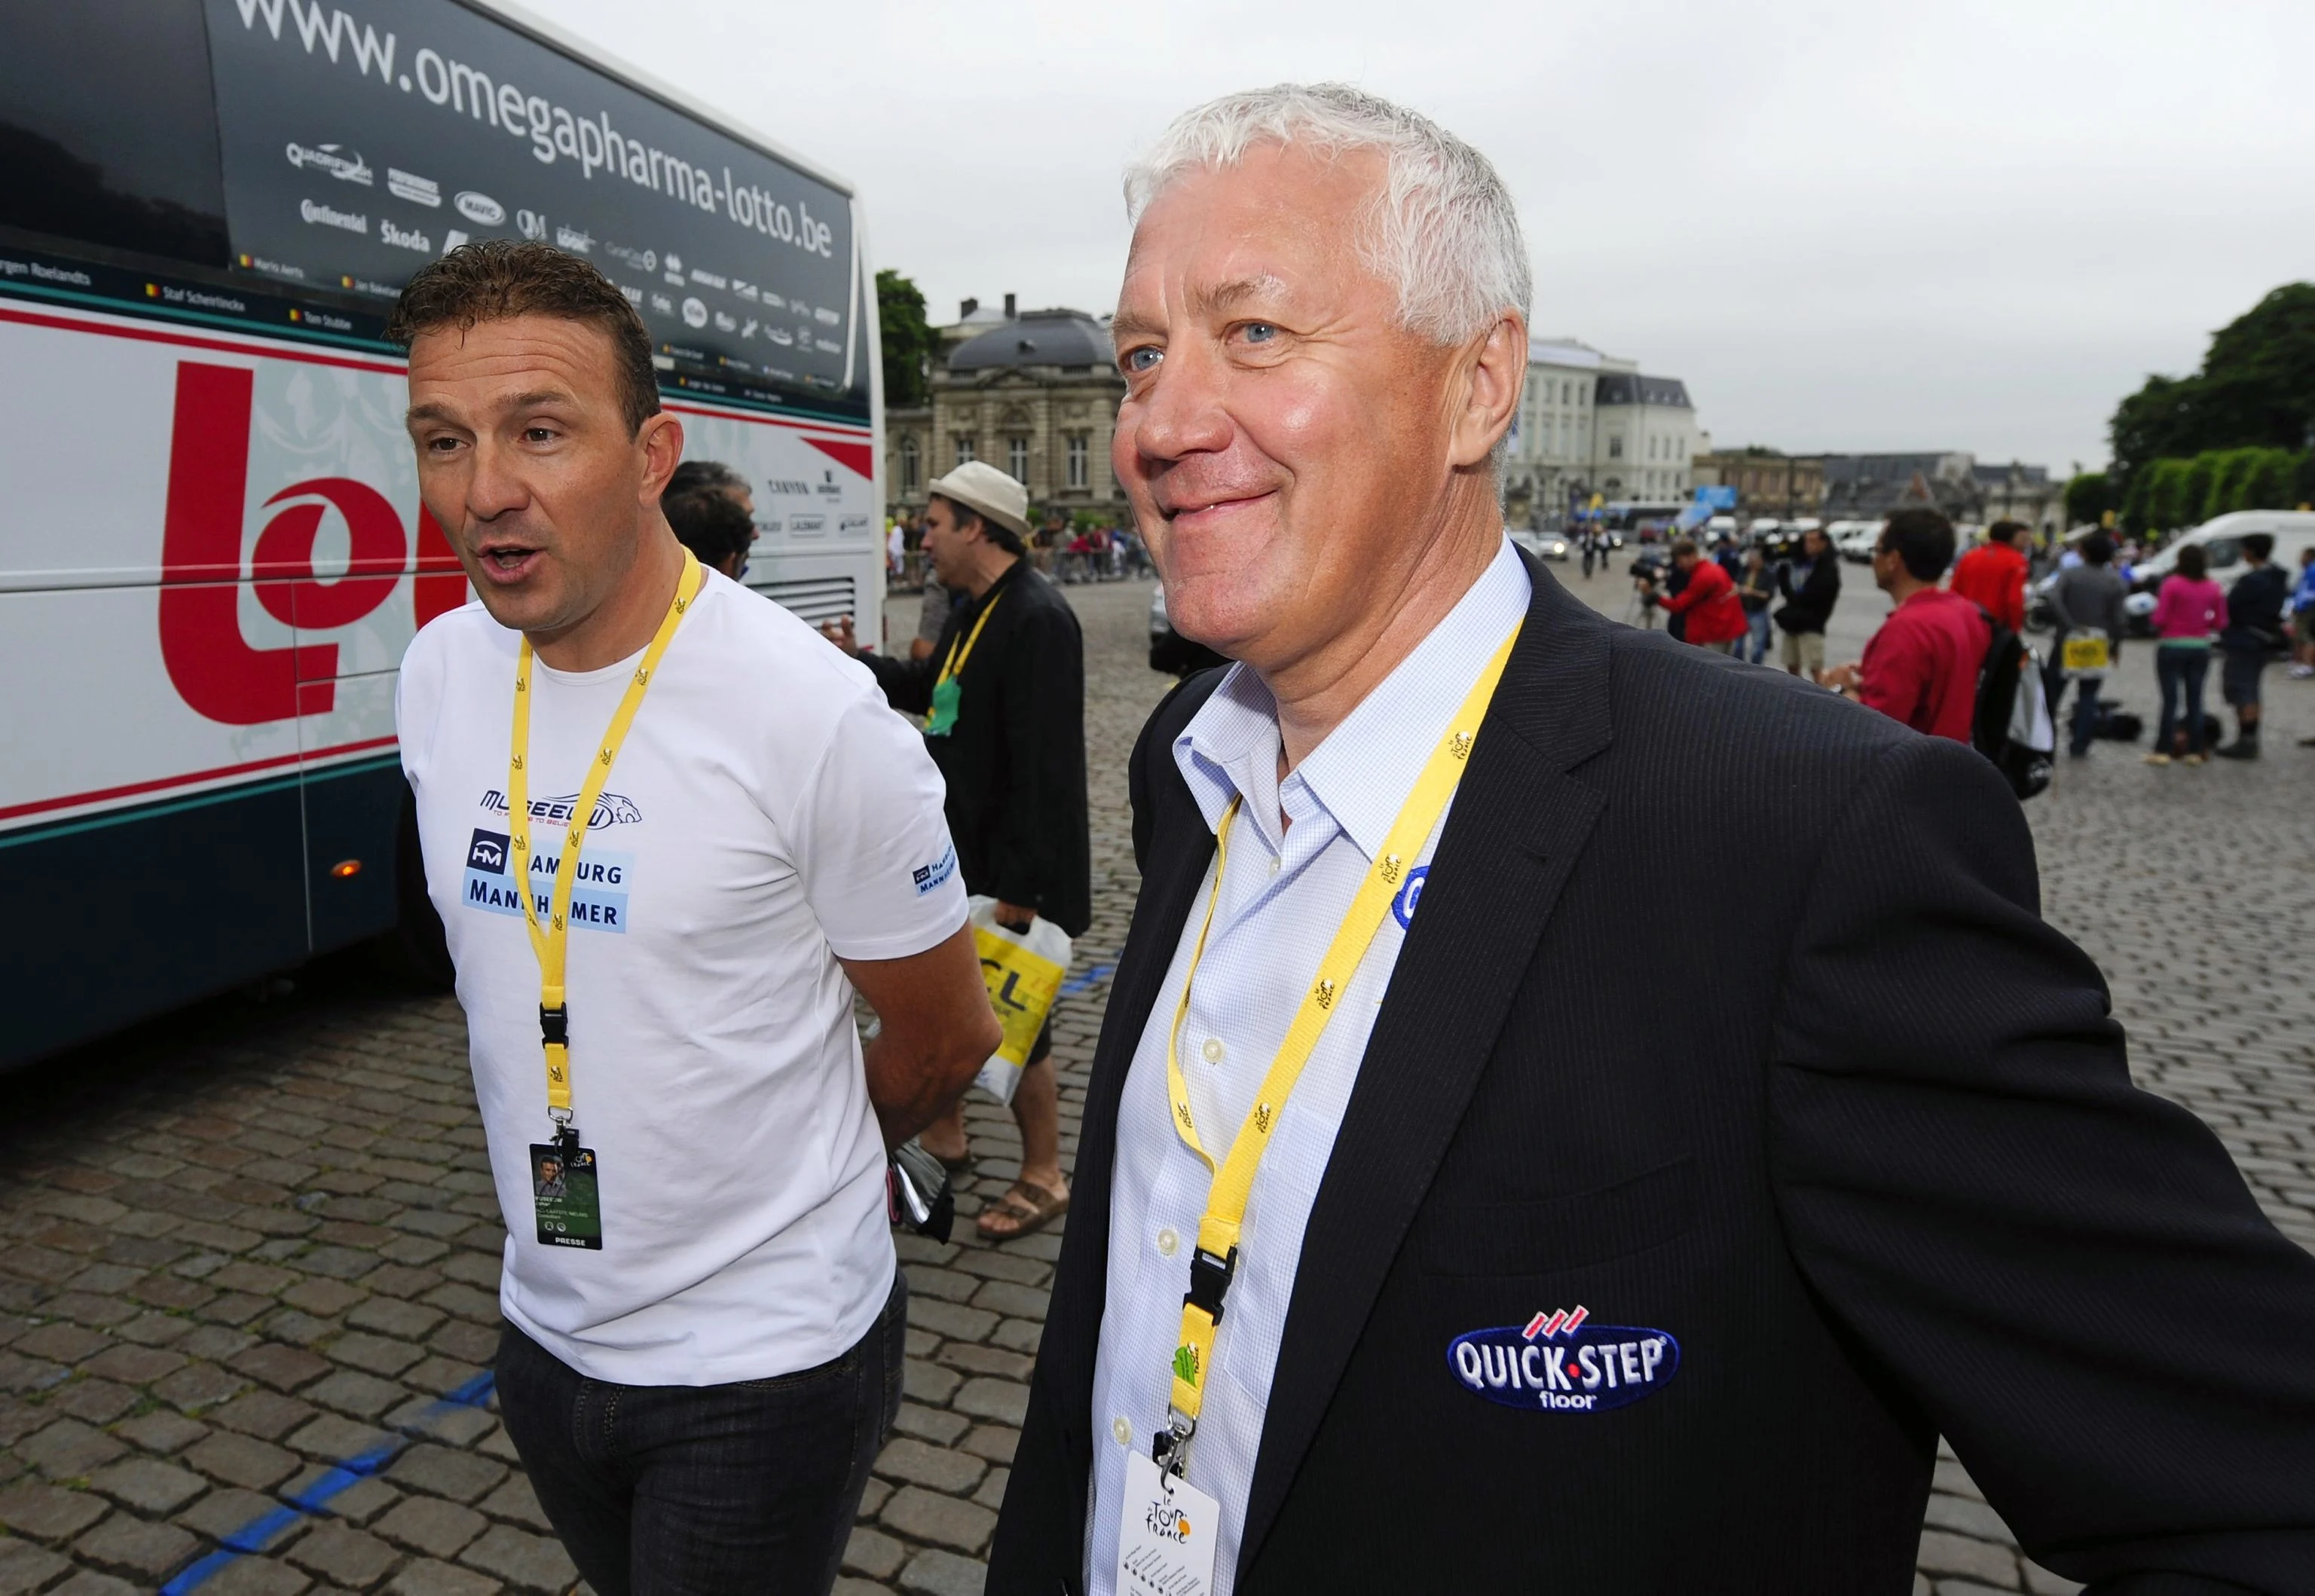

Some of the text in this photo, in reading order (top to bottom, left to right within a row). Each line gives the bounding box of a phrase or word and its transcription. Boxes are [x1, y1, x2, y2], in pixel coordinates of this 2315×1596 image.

[526, 854, 622, 885] AMURG
[469, 878, 617, 925] MANHMER
[555, 1237, 586, 1246] PRESSE
[1539, 1390, 1598, 1409] floor
